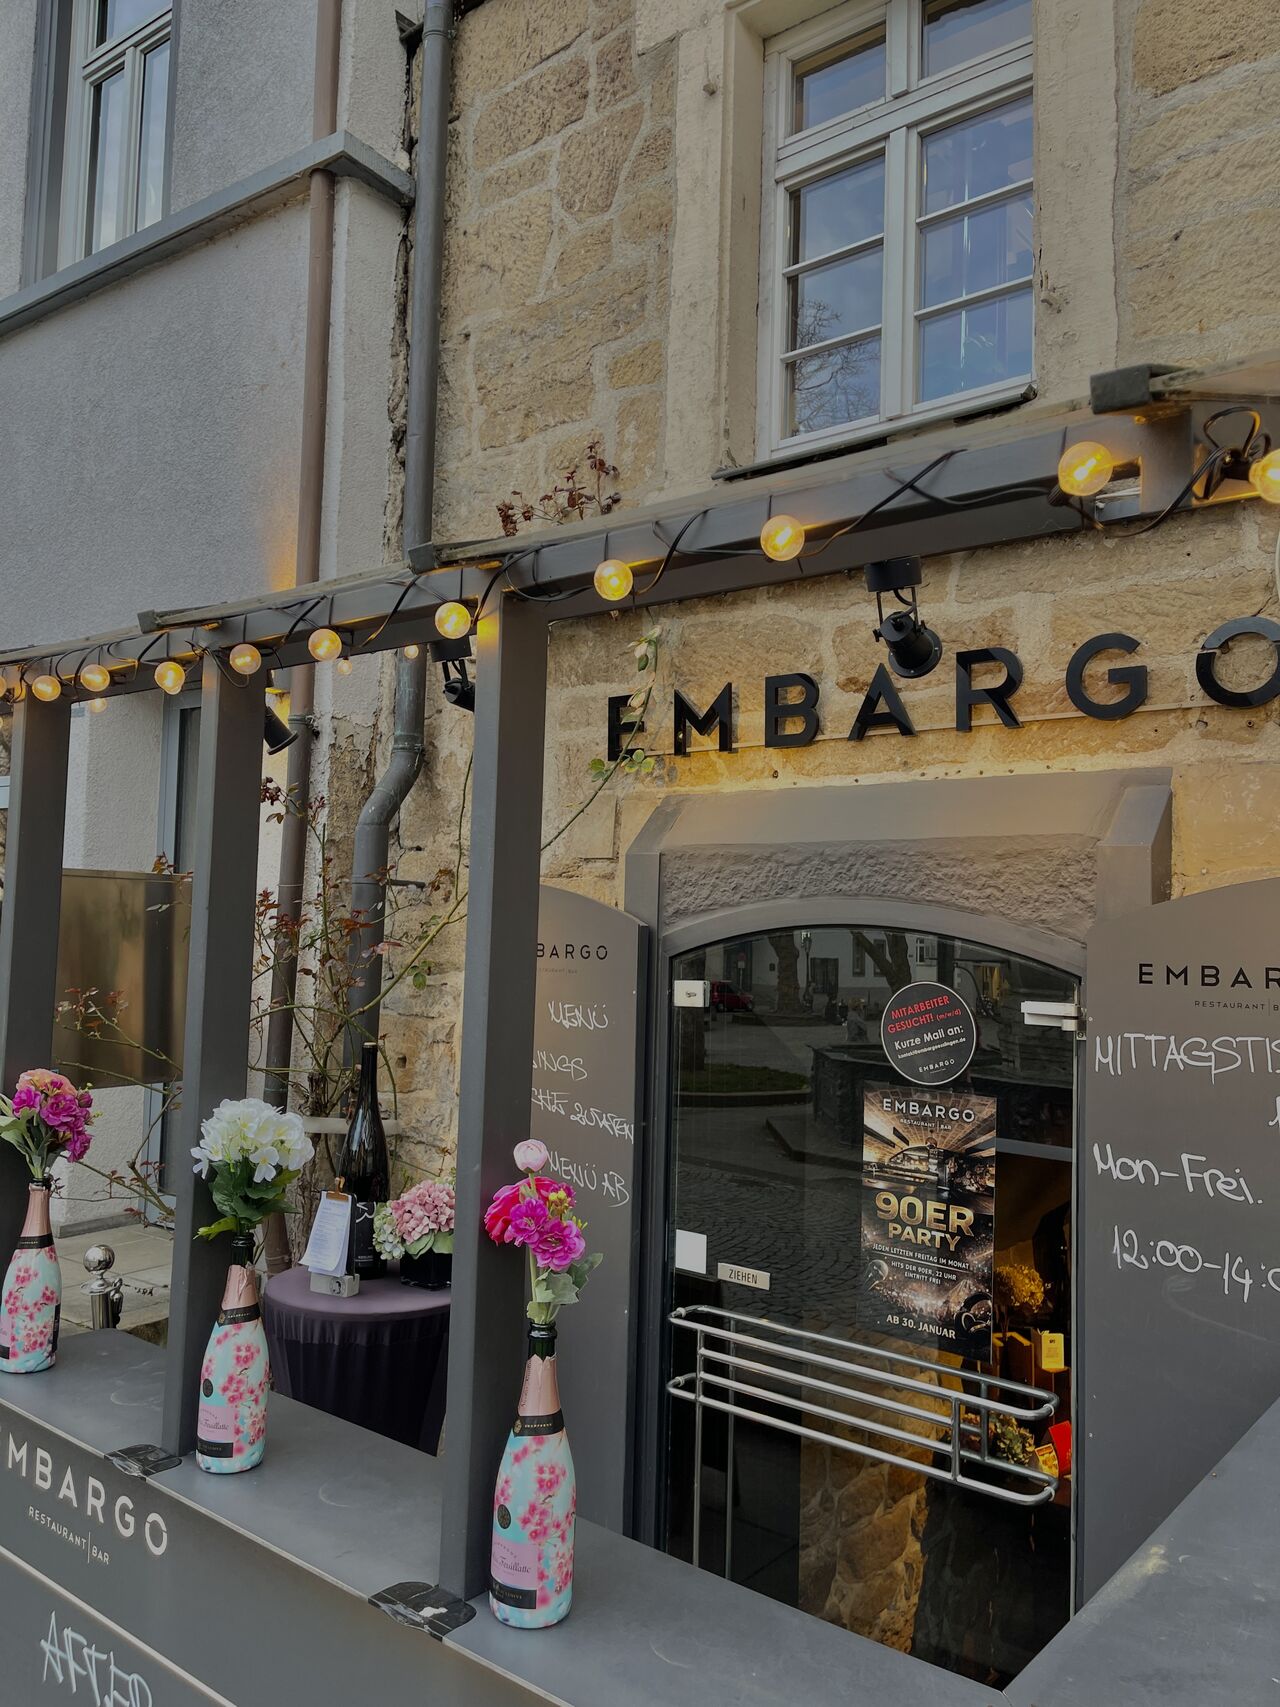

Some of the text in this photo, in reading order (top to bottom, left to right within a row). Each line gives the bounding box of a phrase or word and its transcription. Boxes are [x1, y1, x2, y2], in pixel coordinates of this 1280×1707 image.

[607, 616, 1280, 761] EMBARGO
[547, 1001, 610, 1031] MENÜ
[891, 995, 950, 1020] MITARBEITER
[1194, 1000, 1266, 1011] RESTAURANT
[887, 1008, 962, 1034] GESUCHT! (m/w/d)
[894, 1025, 964, 1051] Kurze Mail an:
[531, 1050, 588, 1081] INGS
[918, 1058, 955, 1073] EMBARGO
[882, 1098, 975, 1122] EMBARGO
[900, 1118, 935, 1129] RESTAURANT
[547, 1150, 630, 1208] MENÜ AB
[874, 1191, 974, 1237] 90ER
[888, 1222, 961, 1252] PARTY
[872, 1243, 970, 1270] JEDEN LETZTEN FREITAG IM MONAT
[728, 1268, 758, 1285] ZIEHEN
[891, 1261, 904, 1269] HITS
[905, 1264, 917, 1272] DER
[943, 1272, 957, 1281] UHR
[904, 1271, 941, 1285] EINTRITT FREI
[886, 1314, 956, 1340] AB 30. JANUAR
[0, 1426, 168, 1556] MBARGO
[28, 1505, 110, 1565] RESTAURANT BAR
